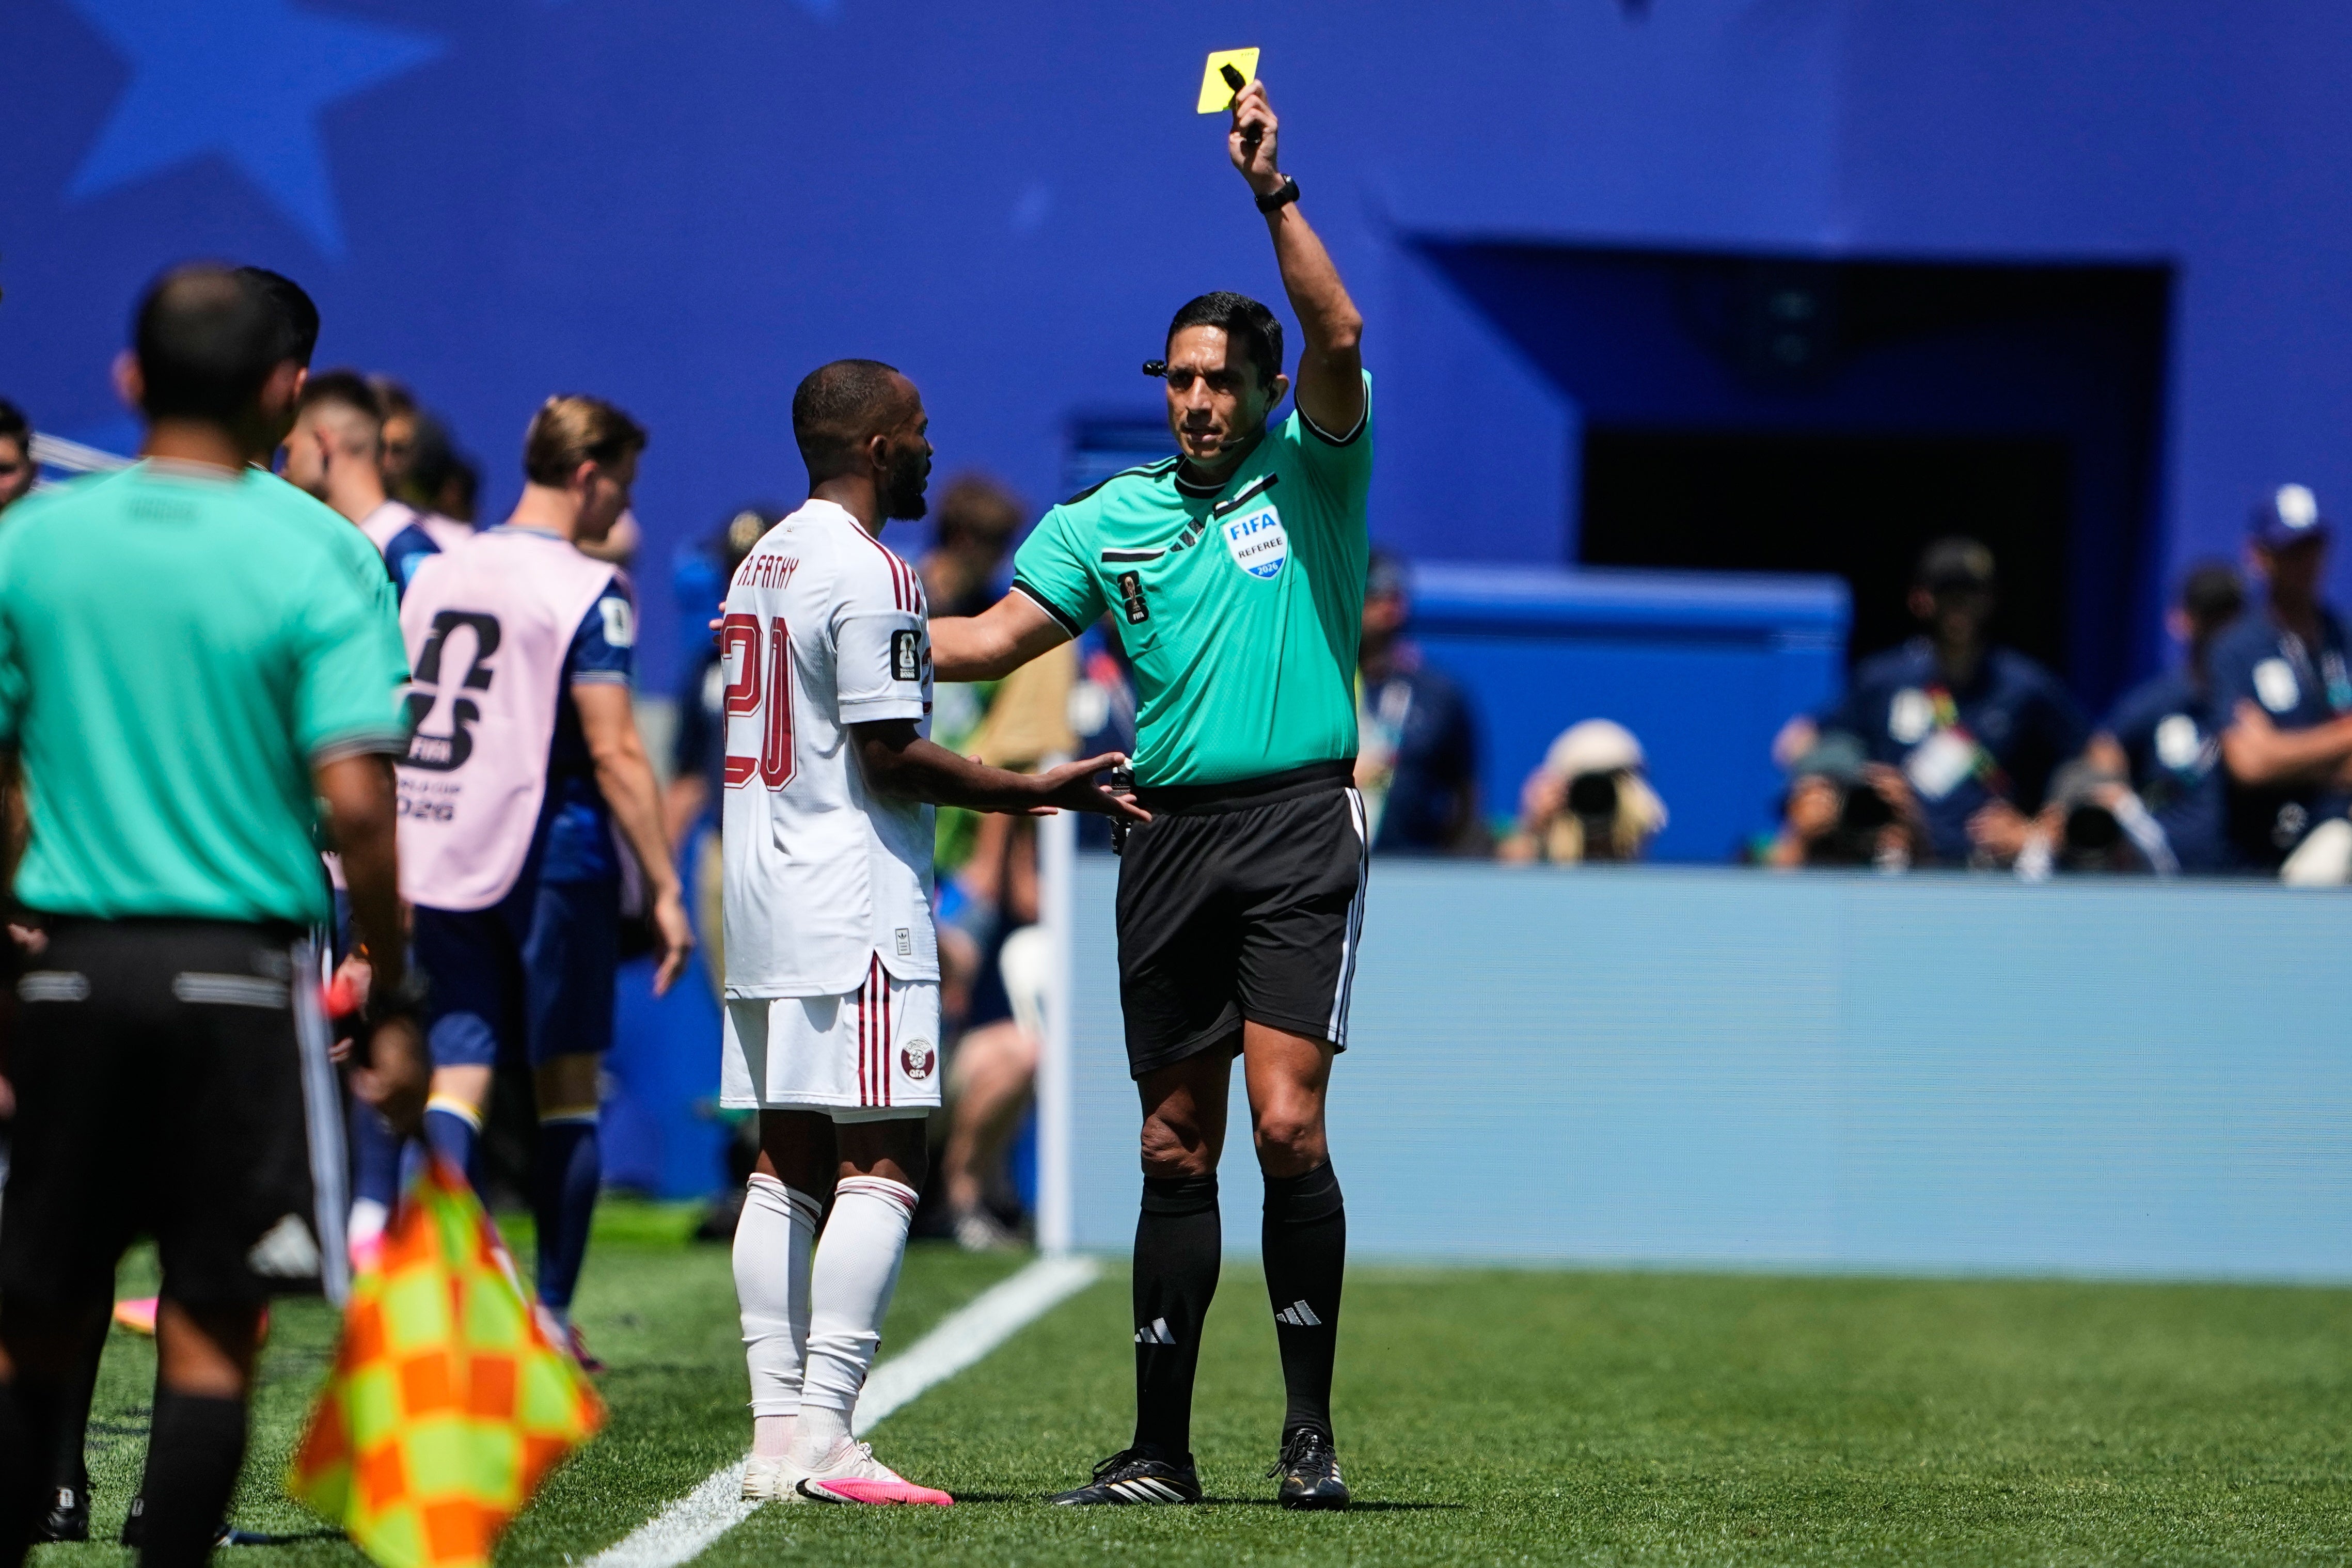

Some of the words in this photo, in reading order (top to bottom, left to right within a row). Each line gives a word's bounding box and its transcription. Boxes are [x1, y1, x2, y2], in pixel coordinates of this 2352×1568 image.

[1230, 513, 1277, 541] FIFA
[1238, 536, 1283, 558] REFEREE
[737, 555, 799, 590] A.FATHY
[1257, 561, 1279, 575] 2026
[1132, 611, 1145, 621] FIFA
[722, 613, 797, 792] 20
[909, 1069, 926, 1079] QFA
